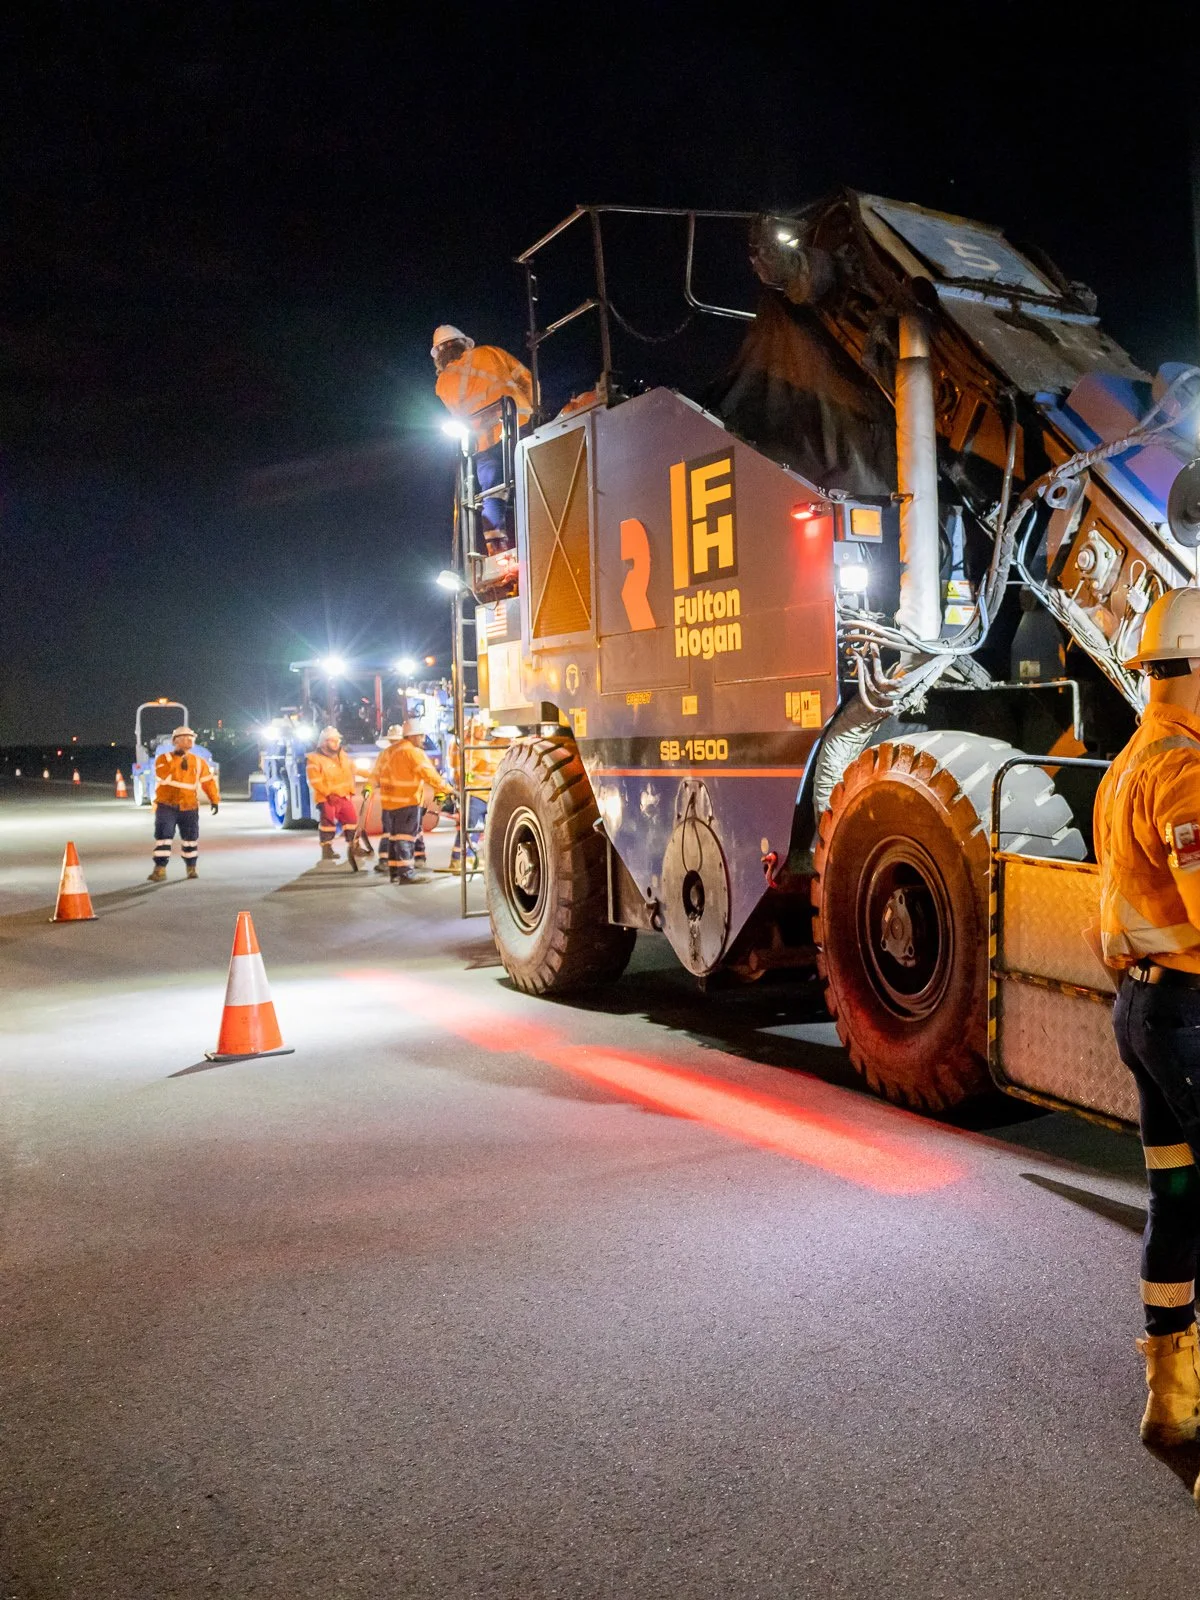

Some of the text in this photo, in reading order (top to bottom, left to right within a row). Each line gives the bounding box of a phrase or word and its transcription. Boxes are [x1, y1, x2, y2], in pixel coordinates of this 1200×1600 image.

[674, 588, 741, 626] Fulton
[675, 621, 742, 660] Hogan
[660, 739, 728, 761] SB-1500
